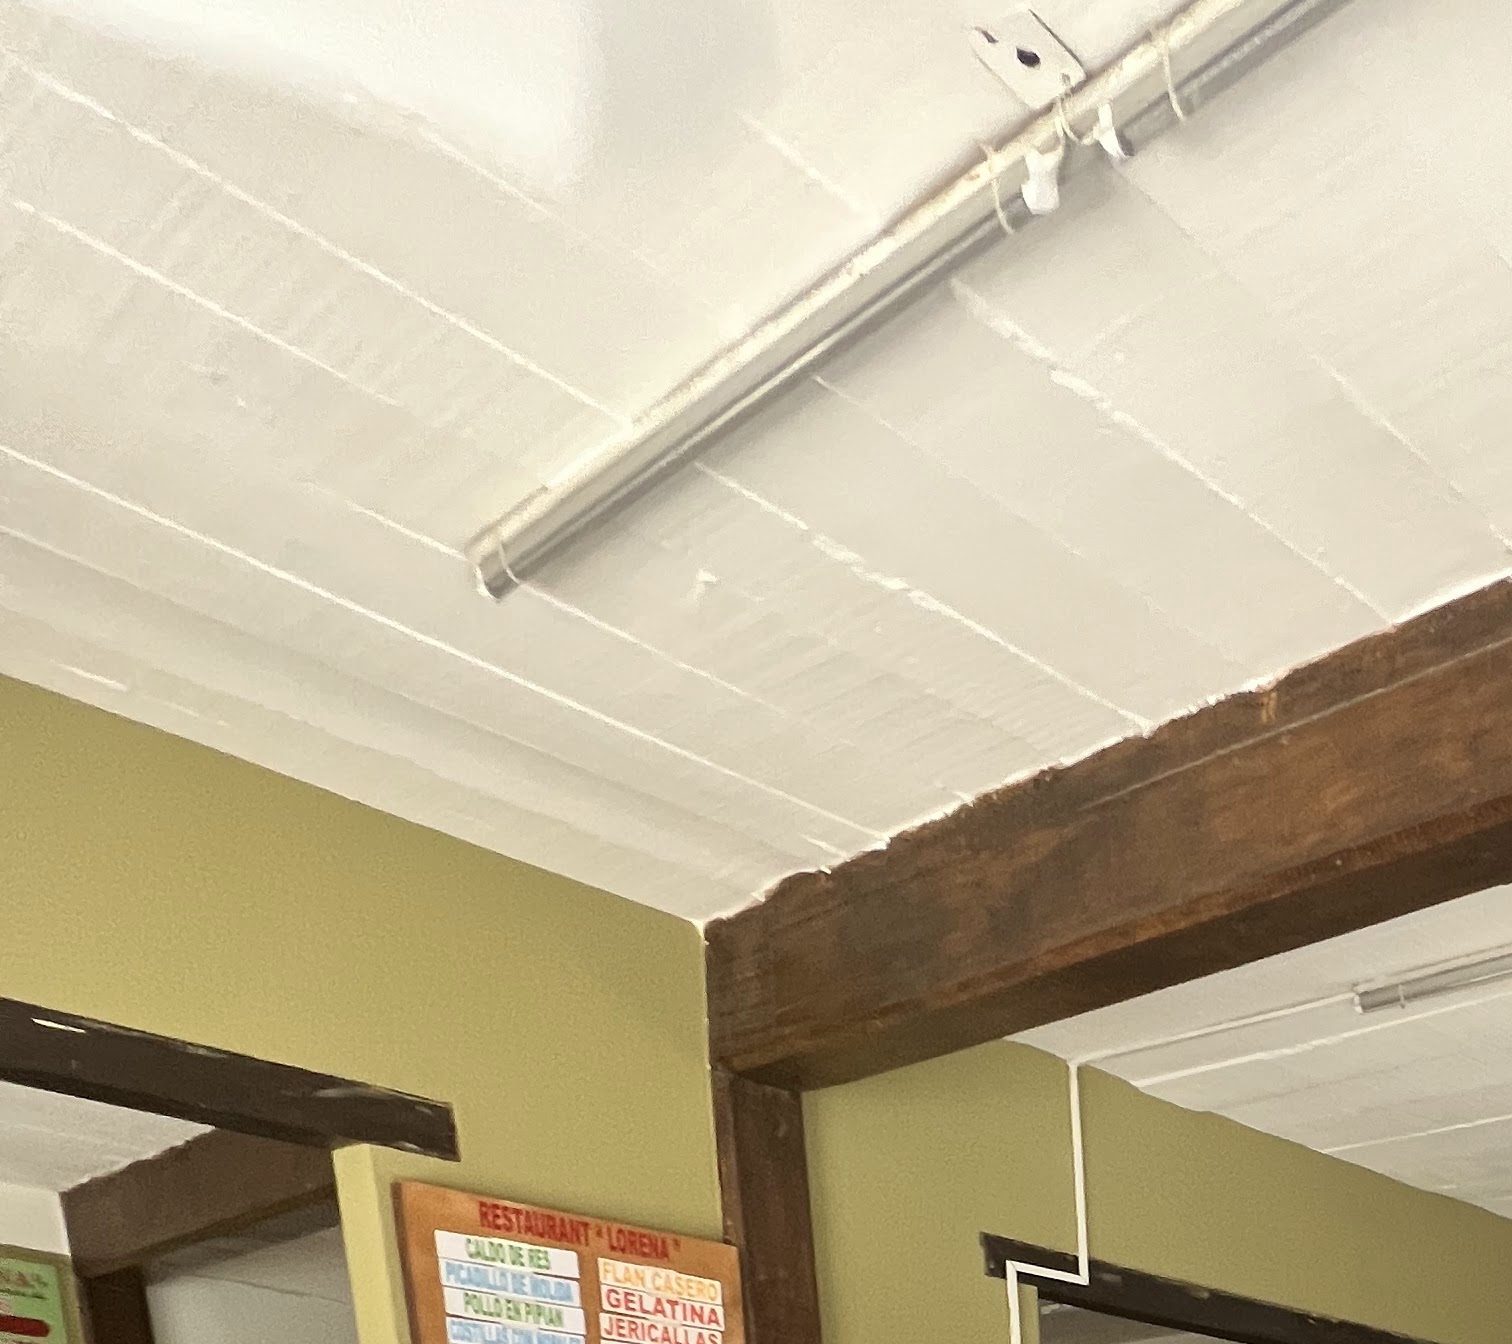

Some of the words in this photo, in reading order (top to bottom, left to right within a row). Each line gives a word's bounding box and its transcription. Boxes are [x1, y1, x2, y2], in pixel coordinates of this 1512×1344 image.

[479, 1201, 589, 1247] RESTAURANT
[465, 1237, 506, 1264] CALDO
[508, 1244, 525, 1267] DE
[528, 1248, 550, 1271] RES
[512, 1273, 528, 1296] DE
[602, 1262, 645, 1289] FLAN
[652, 1272, 718, 1302] CASERO
[464, 1292, 502, 1318] POLLO
[505, 1299, 522, 1322] EN
[605, 1288, 721, 1328] GELATINA
